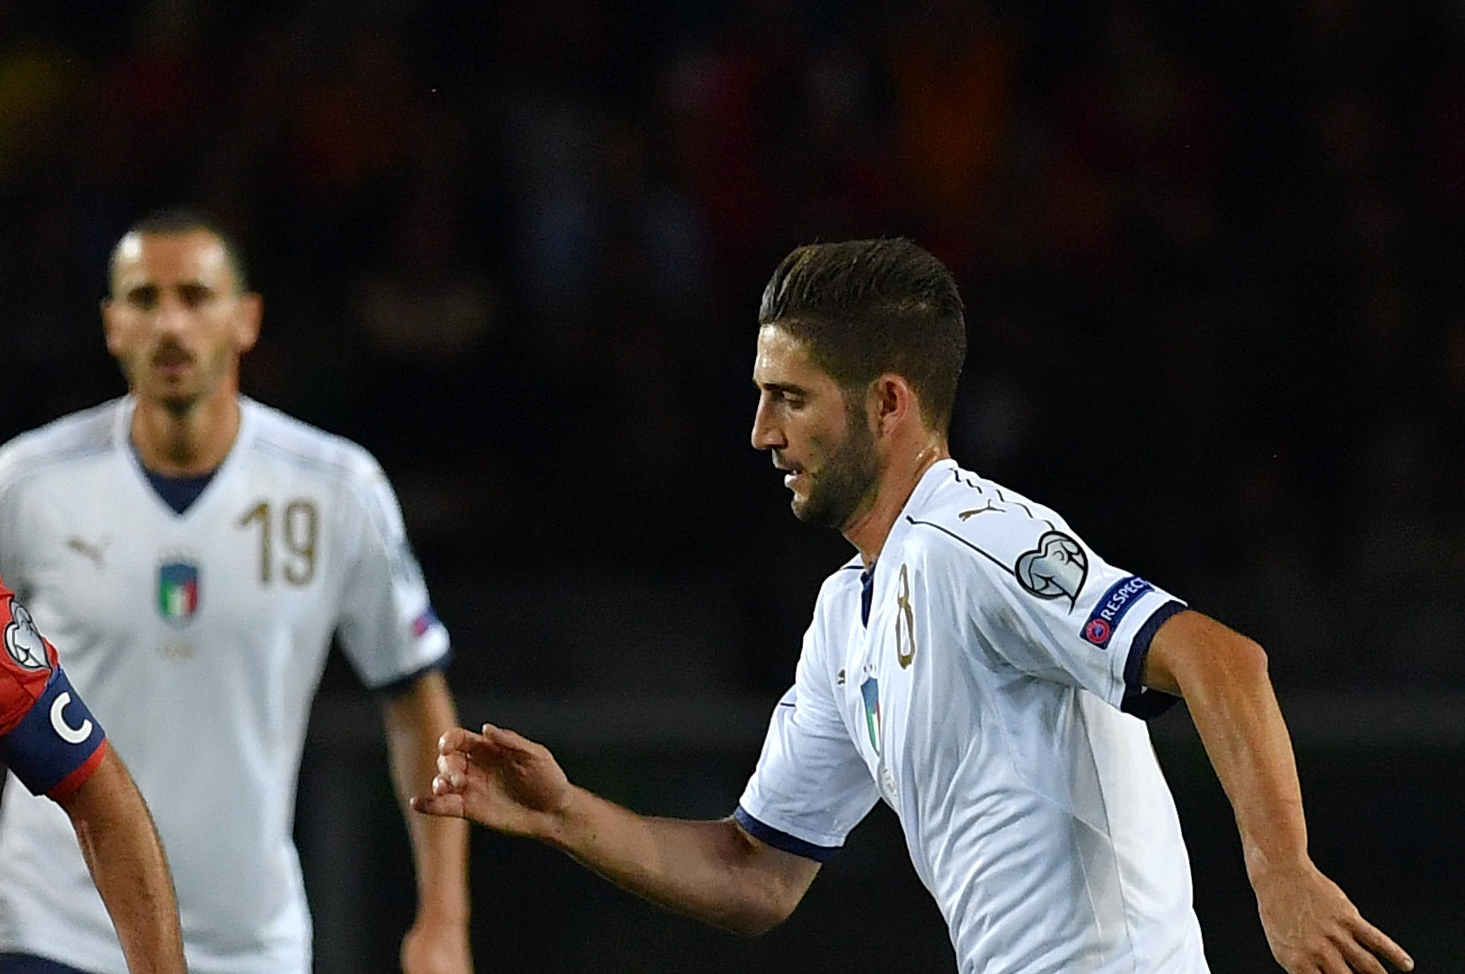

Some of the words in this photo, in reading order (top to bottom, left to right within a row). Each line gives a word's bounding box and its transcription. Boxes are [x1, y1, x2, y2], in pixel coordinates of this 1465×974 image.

[239, 497, 319, 586] 19
[895, 562, 916, 669] 8
[50, 691, 93, 744] C
